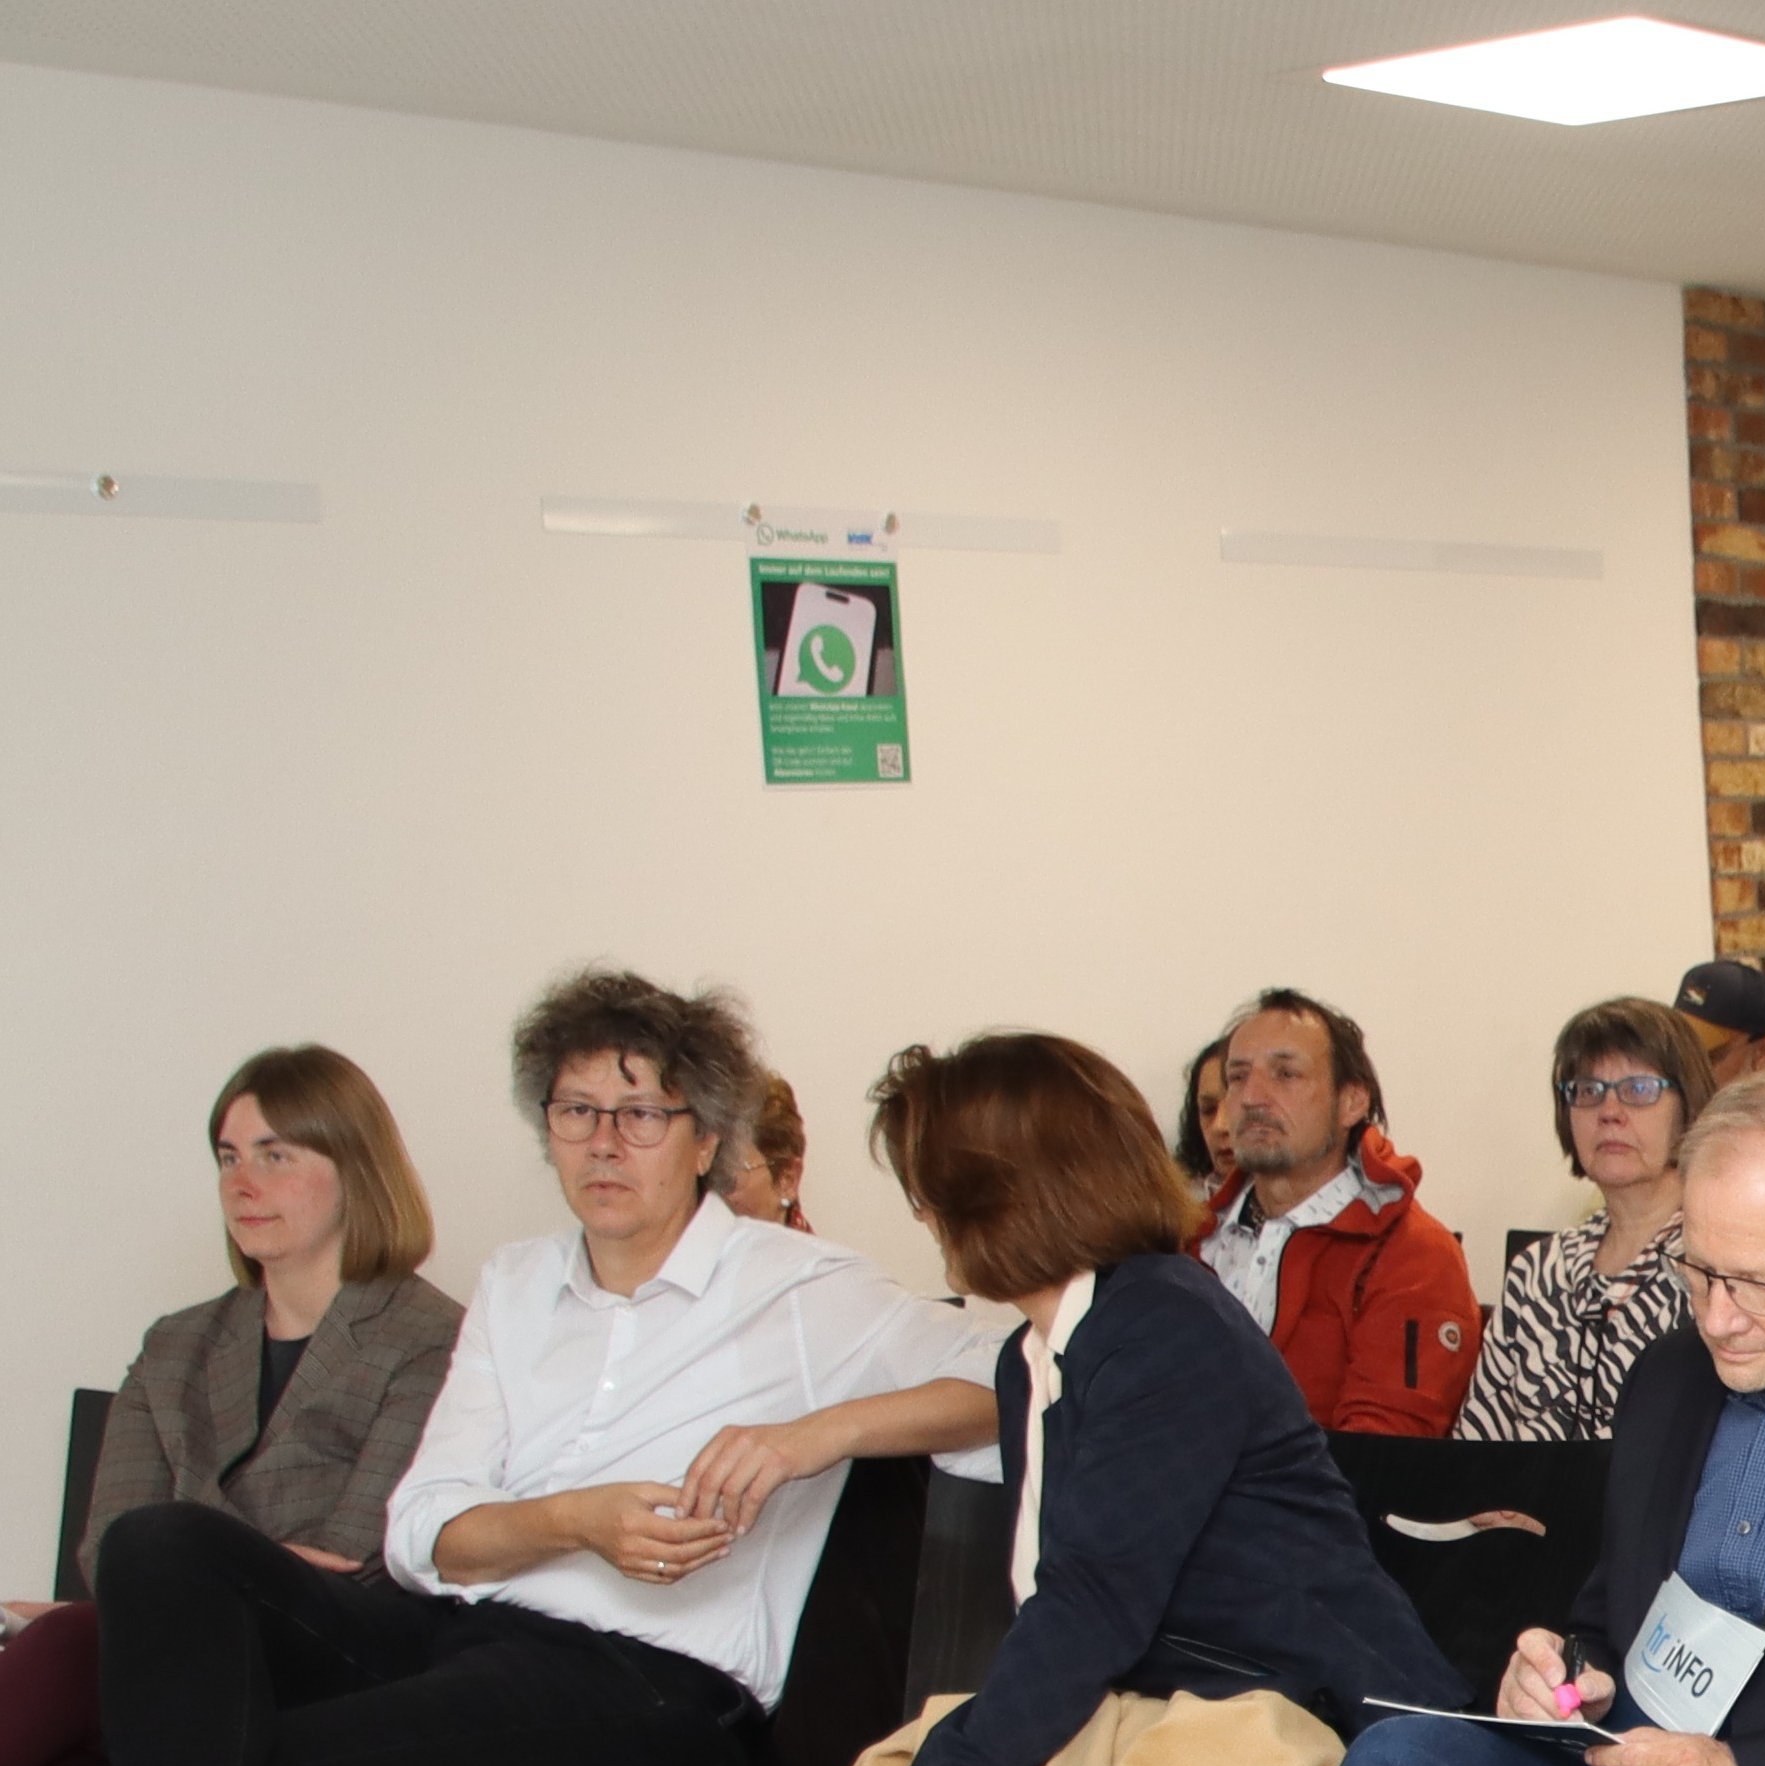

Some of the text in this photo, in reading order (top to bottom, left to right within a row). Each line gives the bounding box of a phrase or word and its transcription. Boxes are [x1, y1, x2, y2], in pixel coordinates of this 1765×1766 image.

[776, 529, 828, 544] WhatsApp
[1646, 1613, 1714, 1698] hr iNFO
